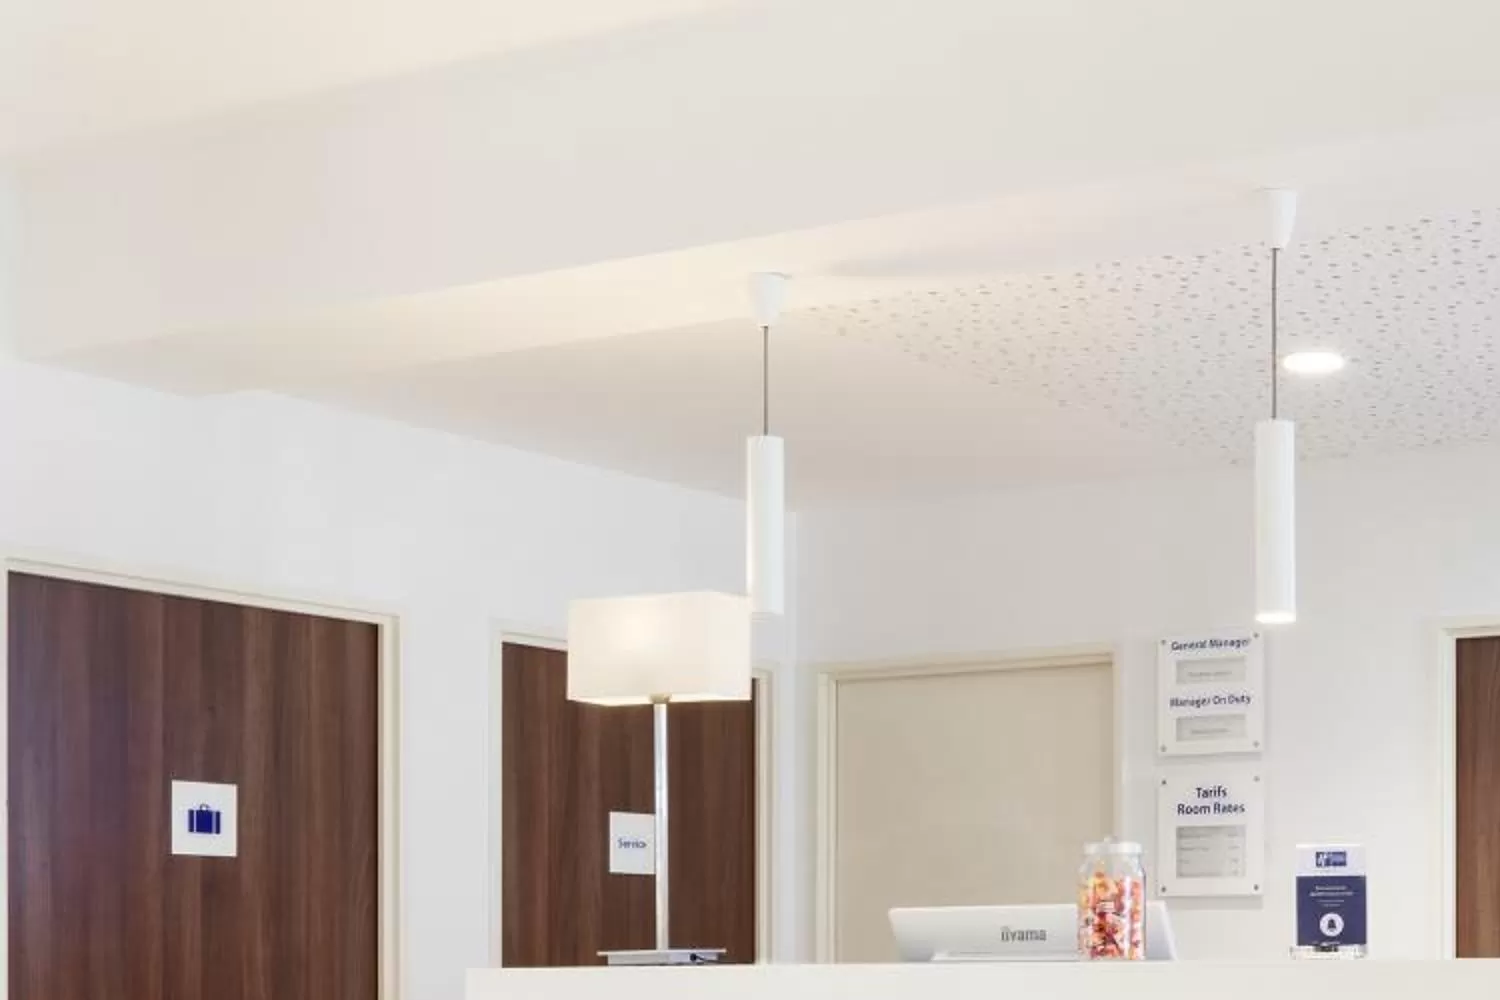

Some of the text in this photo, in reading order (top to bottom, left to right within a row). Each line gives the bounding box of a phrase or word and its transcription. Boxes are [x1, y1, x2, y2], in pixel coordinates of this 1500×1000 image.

[1171, 638, 1251, 651] General Manager
[1169, 695, 1252, 708] Manager On Duty
[1195, 785, 1228, 798] Tarifs
[1177, 801, 1246, 815] Room Rates
[1000, 926, 1047, 942] iiyama
